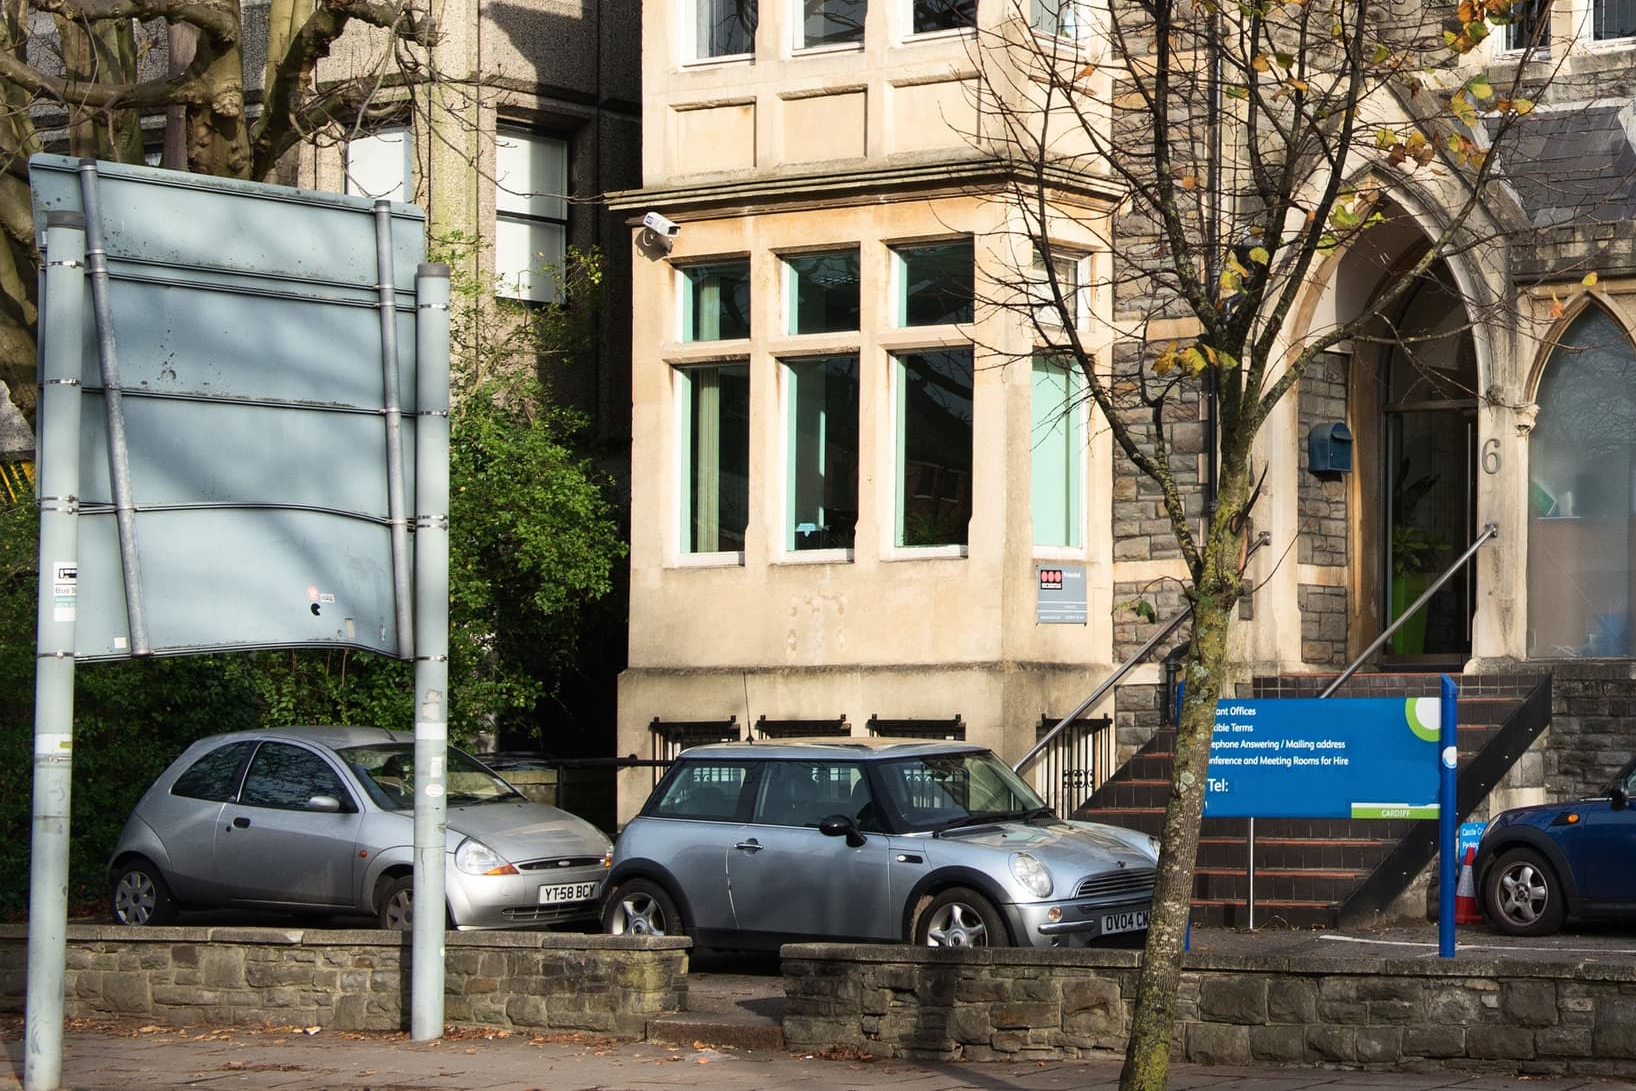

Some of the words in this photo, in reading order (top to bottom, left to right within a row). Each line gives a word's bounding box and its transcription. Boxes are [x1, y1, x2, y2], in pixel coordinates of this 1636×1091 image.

[1481, 438, 1502, 475] 6
[1230, 706, 1256, 716] Offices
[1231, 723, 1253, 732] Terms
[1211, 739, 1239, 750] ephone
[1241, 739, 1279, 750] Answering
[1286, 739, 1315, 750] Mailing
[1316, 739, 1346, 749] address
[1209, 756, 1242, 765] nference
[1243, 756, 1258, 765] and
[1260, 756, 1292, 767] Meeting
[1293, 756, 1319, 766] Rooms
[1320, 756, 1332, 766] for
[1333, 756, 1349, 766] Hire
[1207, 778, 1229, 792] Tel:
[545, 886, 574, 901] YT58
[576, 884, 596, 899] BCY
[1106, 913, 1134, 931] OV04
[1136, 910, 1149, 927] CM
